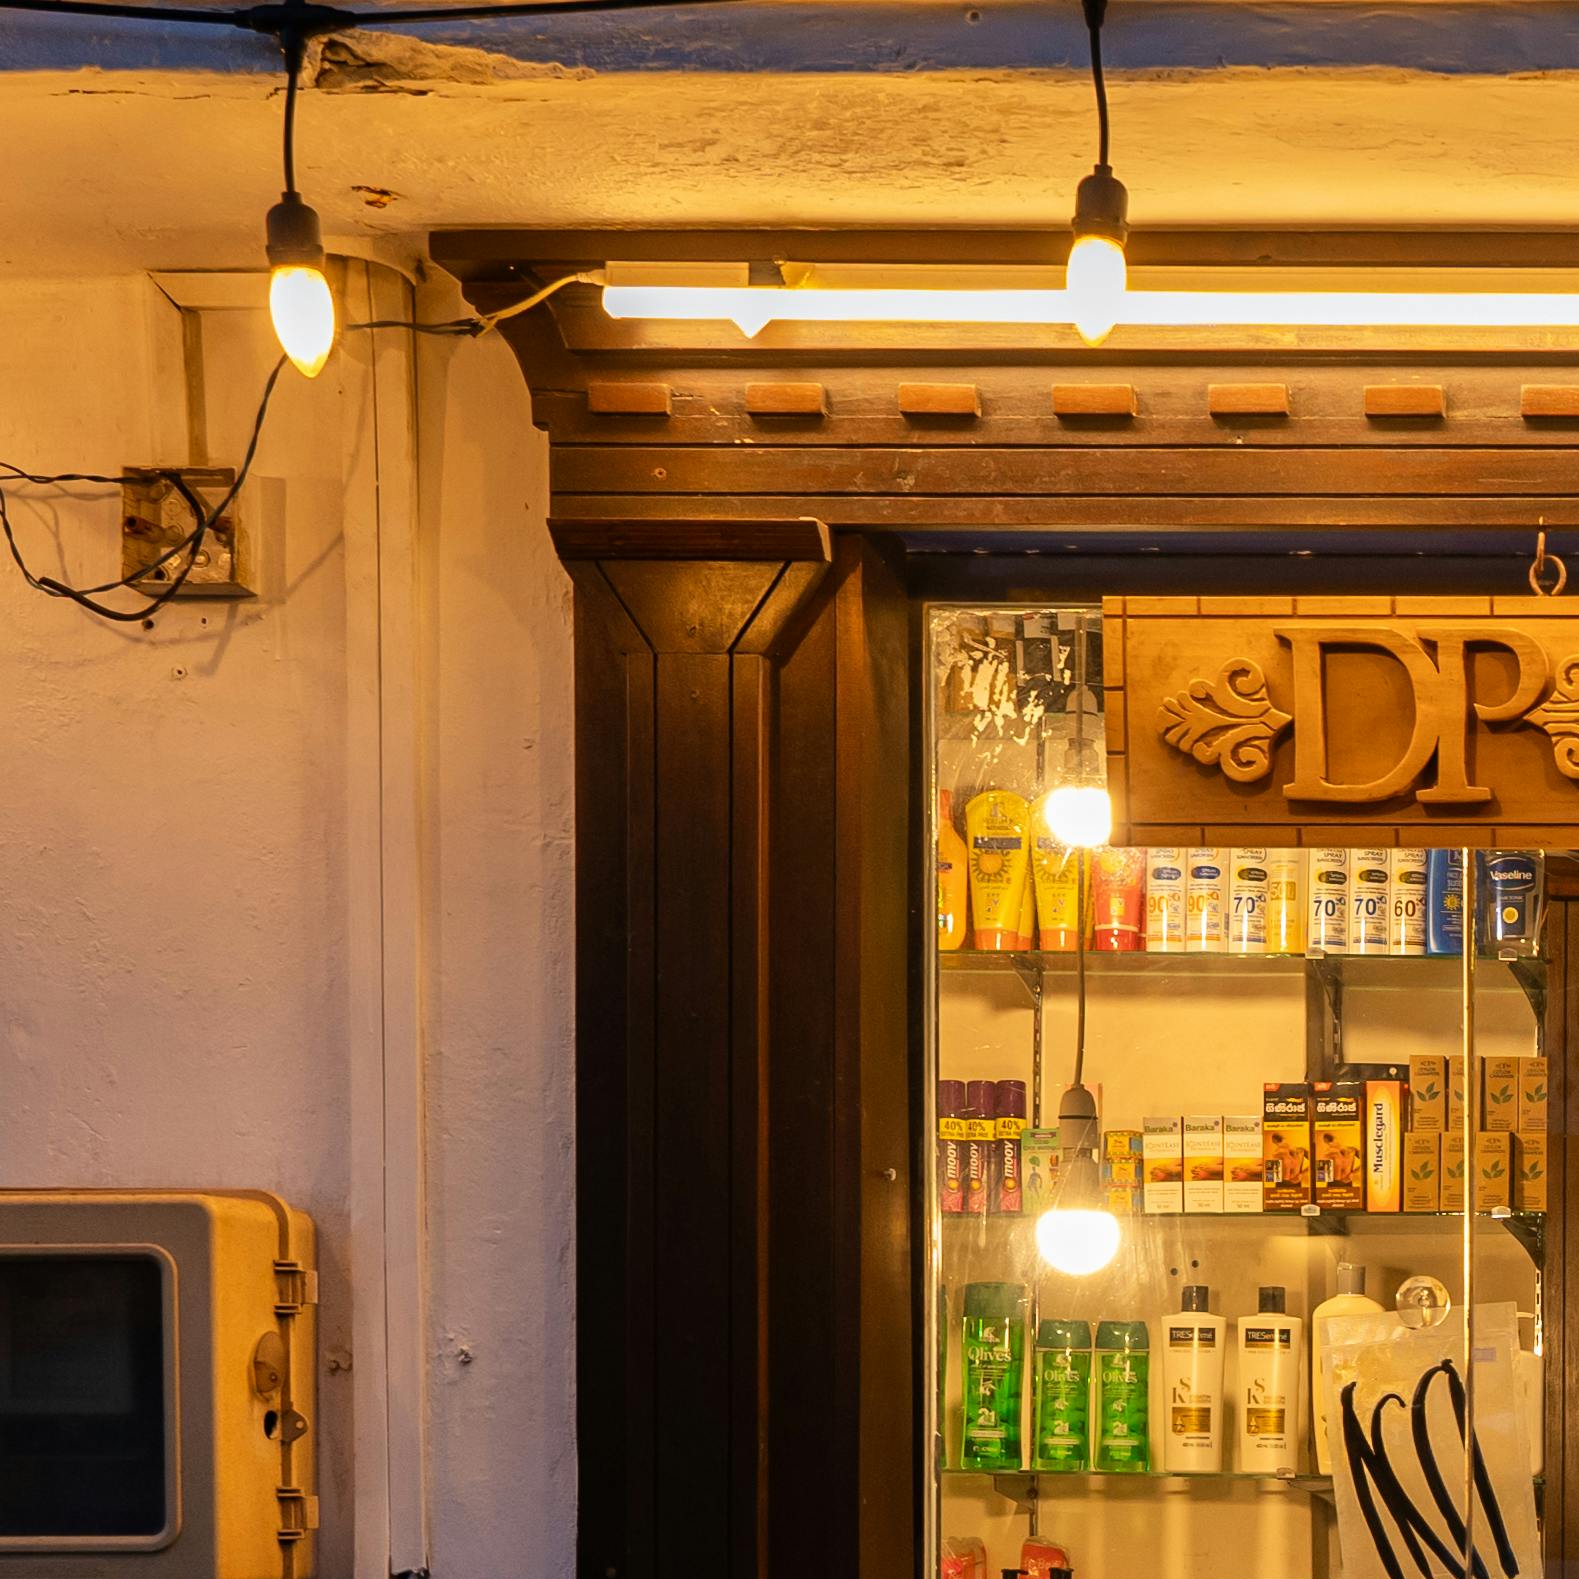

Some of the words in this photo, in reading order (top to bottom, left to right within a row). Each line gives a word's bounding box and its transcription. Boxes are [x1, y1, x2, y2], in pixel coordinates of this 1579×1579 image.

[1275, 626, 1551, 803] DP
[1489, 870, 1533, 881] Vaseline
[1233, 896, 1256, 914] 70
[1314, 900, 1336, 916] 70
[1354, 899, 1377, 916] 70
[1394, 900, 1416, 916] 60
[1144, 1124, 1173, 1133] Baraka
[1185, 1123, 1214, 1132] Baraka
[1226, 1124, 1255, 1132] Baraka
[1373, 1103, 1384, 1174] Musclegard
[946, 1141, 957, 1179] moov
[969, 1143, 979, 1179] moov
[1004, 1140, 1014, 1178] moov
[968, 1345, 1012, 1363] Olives
[1044, 1369, 1080, 1383] Olives
[1102, 1369, 1138, 1383] Olives
